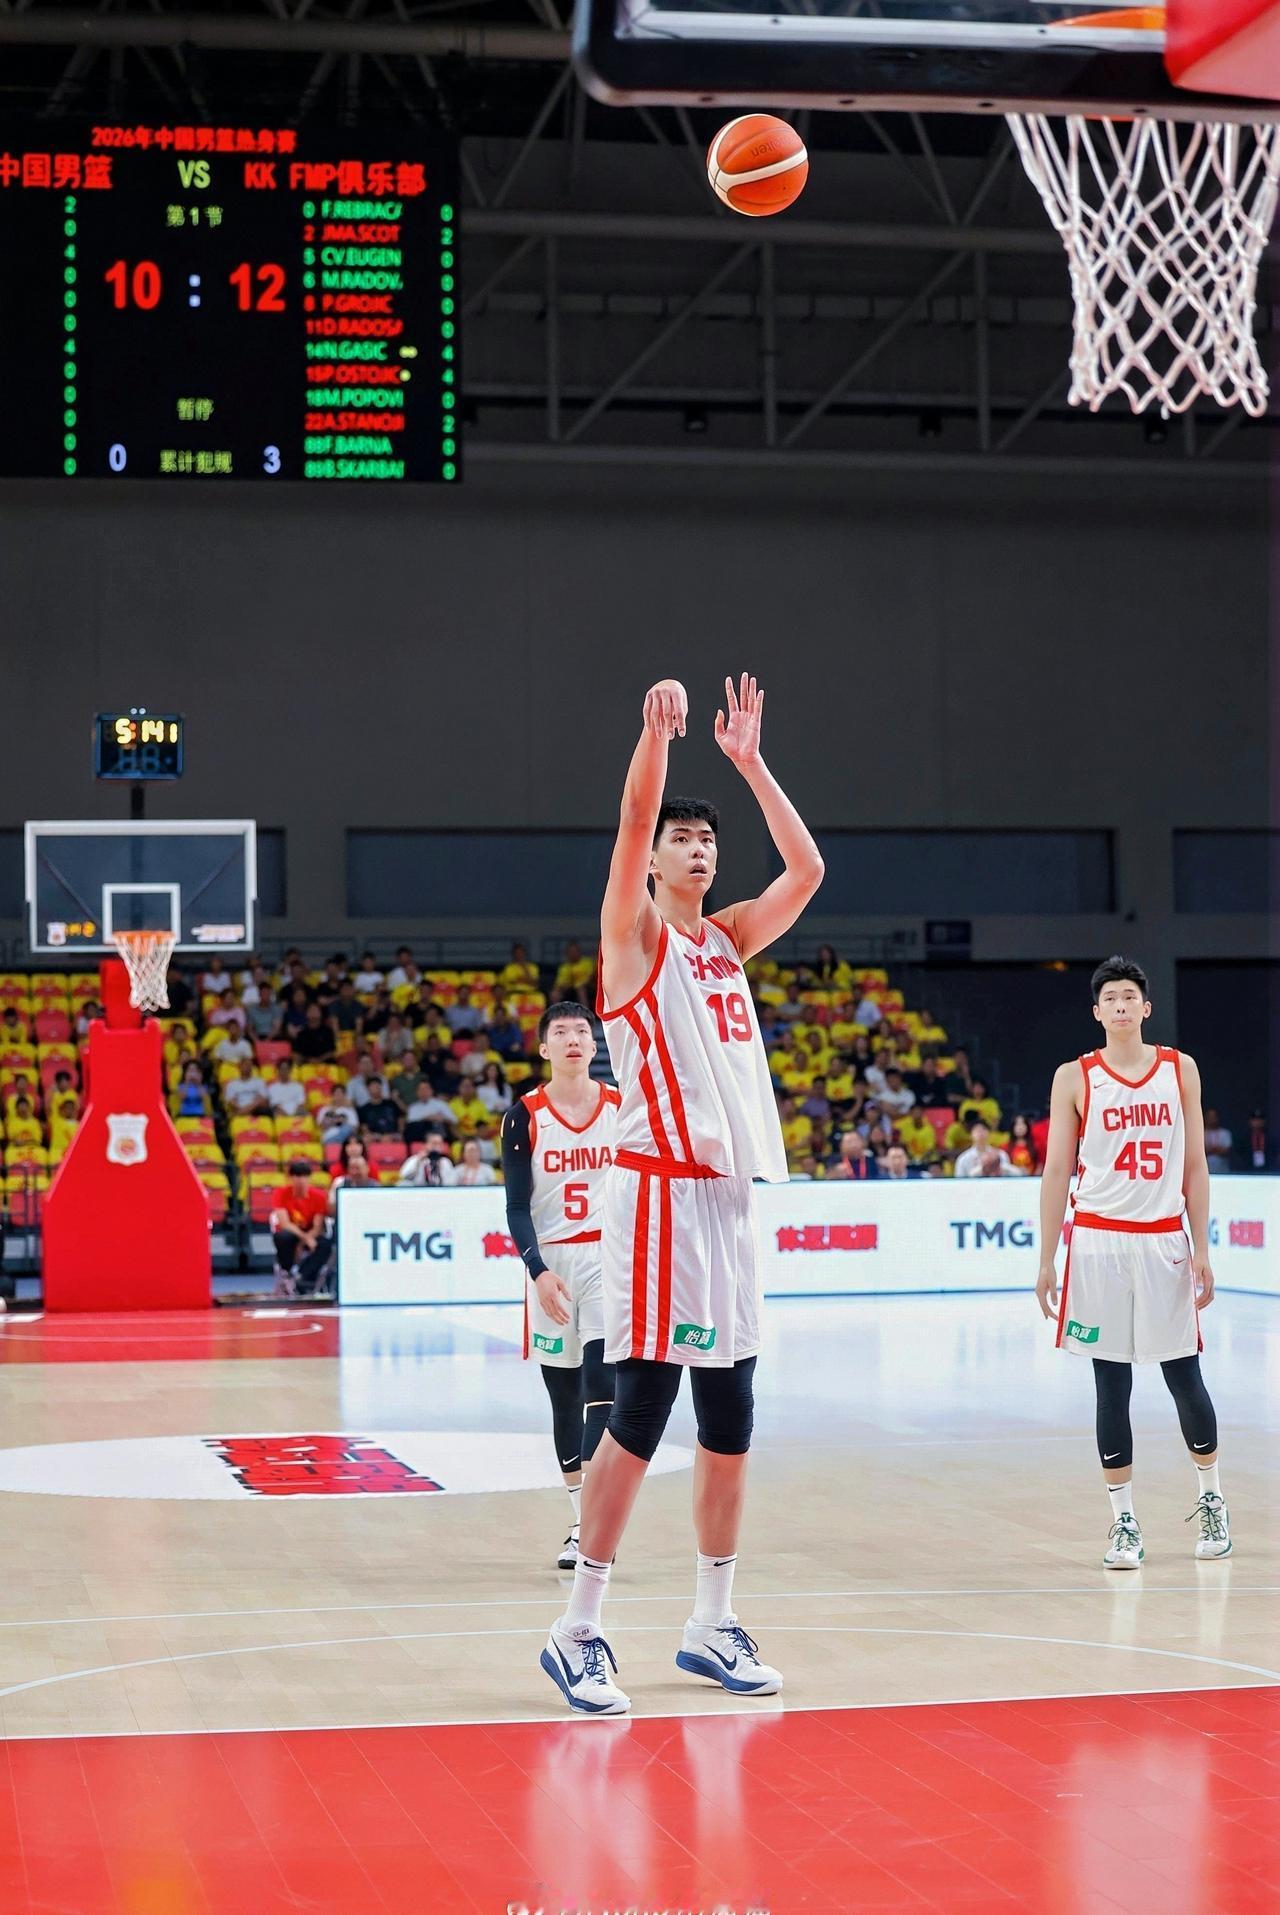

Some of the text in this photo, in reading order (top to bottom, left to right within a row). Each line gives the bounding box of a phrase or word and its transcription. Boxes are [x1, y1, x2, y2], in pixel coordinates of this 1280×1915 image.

[0, 153, 113, 189] 中国男篮
[177, 160, 211, 189] VS
[245, 161, 427, 196] KK FMP俱乐部
[167, 205, 223, 227] 第1节
[105, 261, 162, 310] 10
[229, 264, 286, 312] 12
[109, 444, 127, 472] 0
[263, 445, 282, 474] 3
[706, 992, 753, 1043] 19
[1103, 1103, 1172, 1132] CHINA
[544, 1146, 613, 1173] CHINA
[1114, 1141, 1163, 1181] 45
[564, 1183, 589, 1221] 5
[364, 1231, 452, 1261] TMG
[950, 1221, 1033, 1249] TMG
